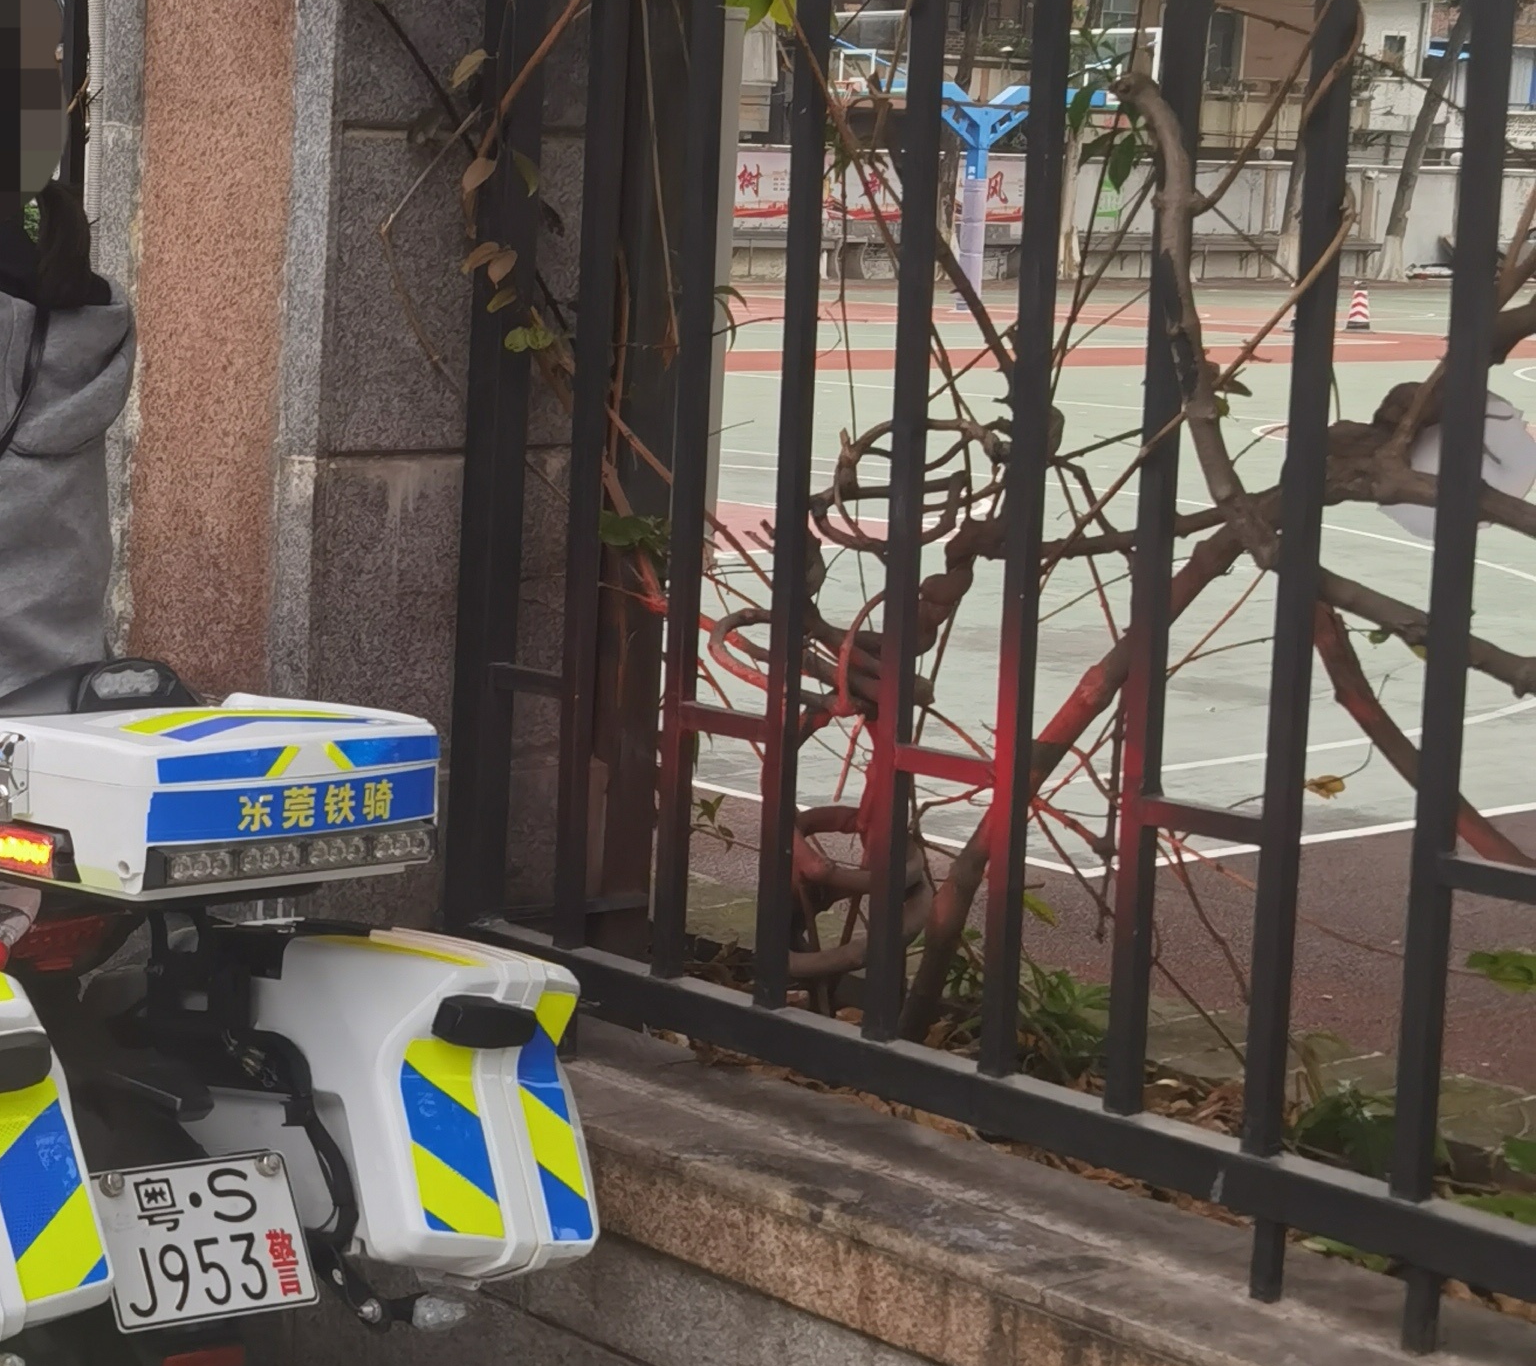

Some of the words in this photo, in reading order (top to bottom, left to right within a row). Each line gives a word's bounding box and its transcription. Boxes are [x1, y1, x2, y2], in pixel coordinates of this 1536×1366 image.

[737, 163, 762, 197] 树
[986, 170, 1009, 204] 风
[238, 779, 394, 832] 东莞铁骑
